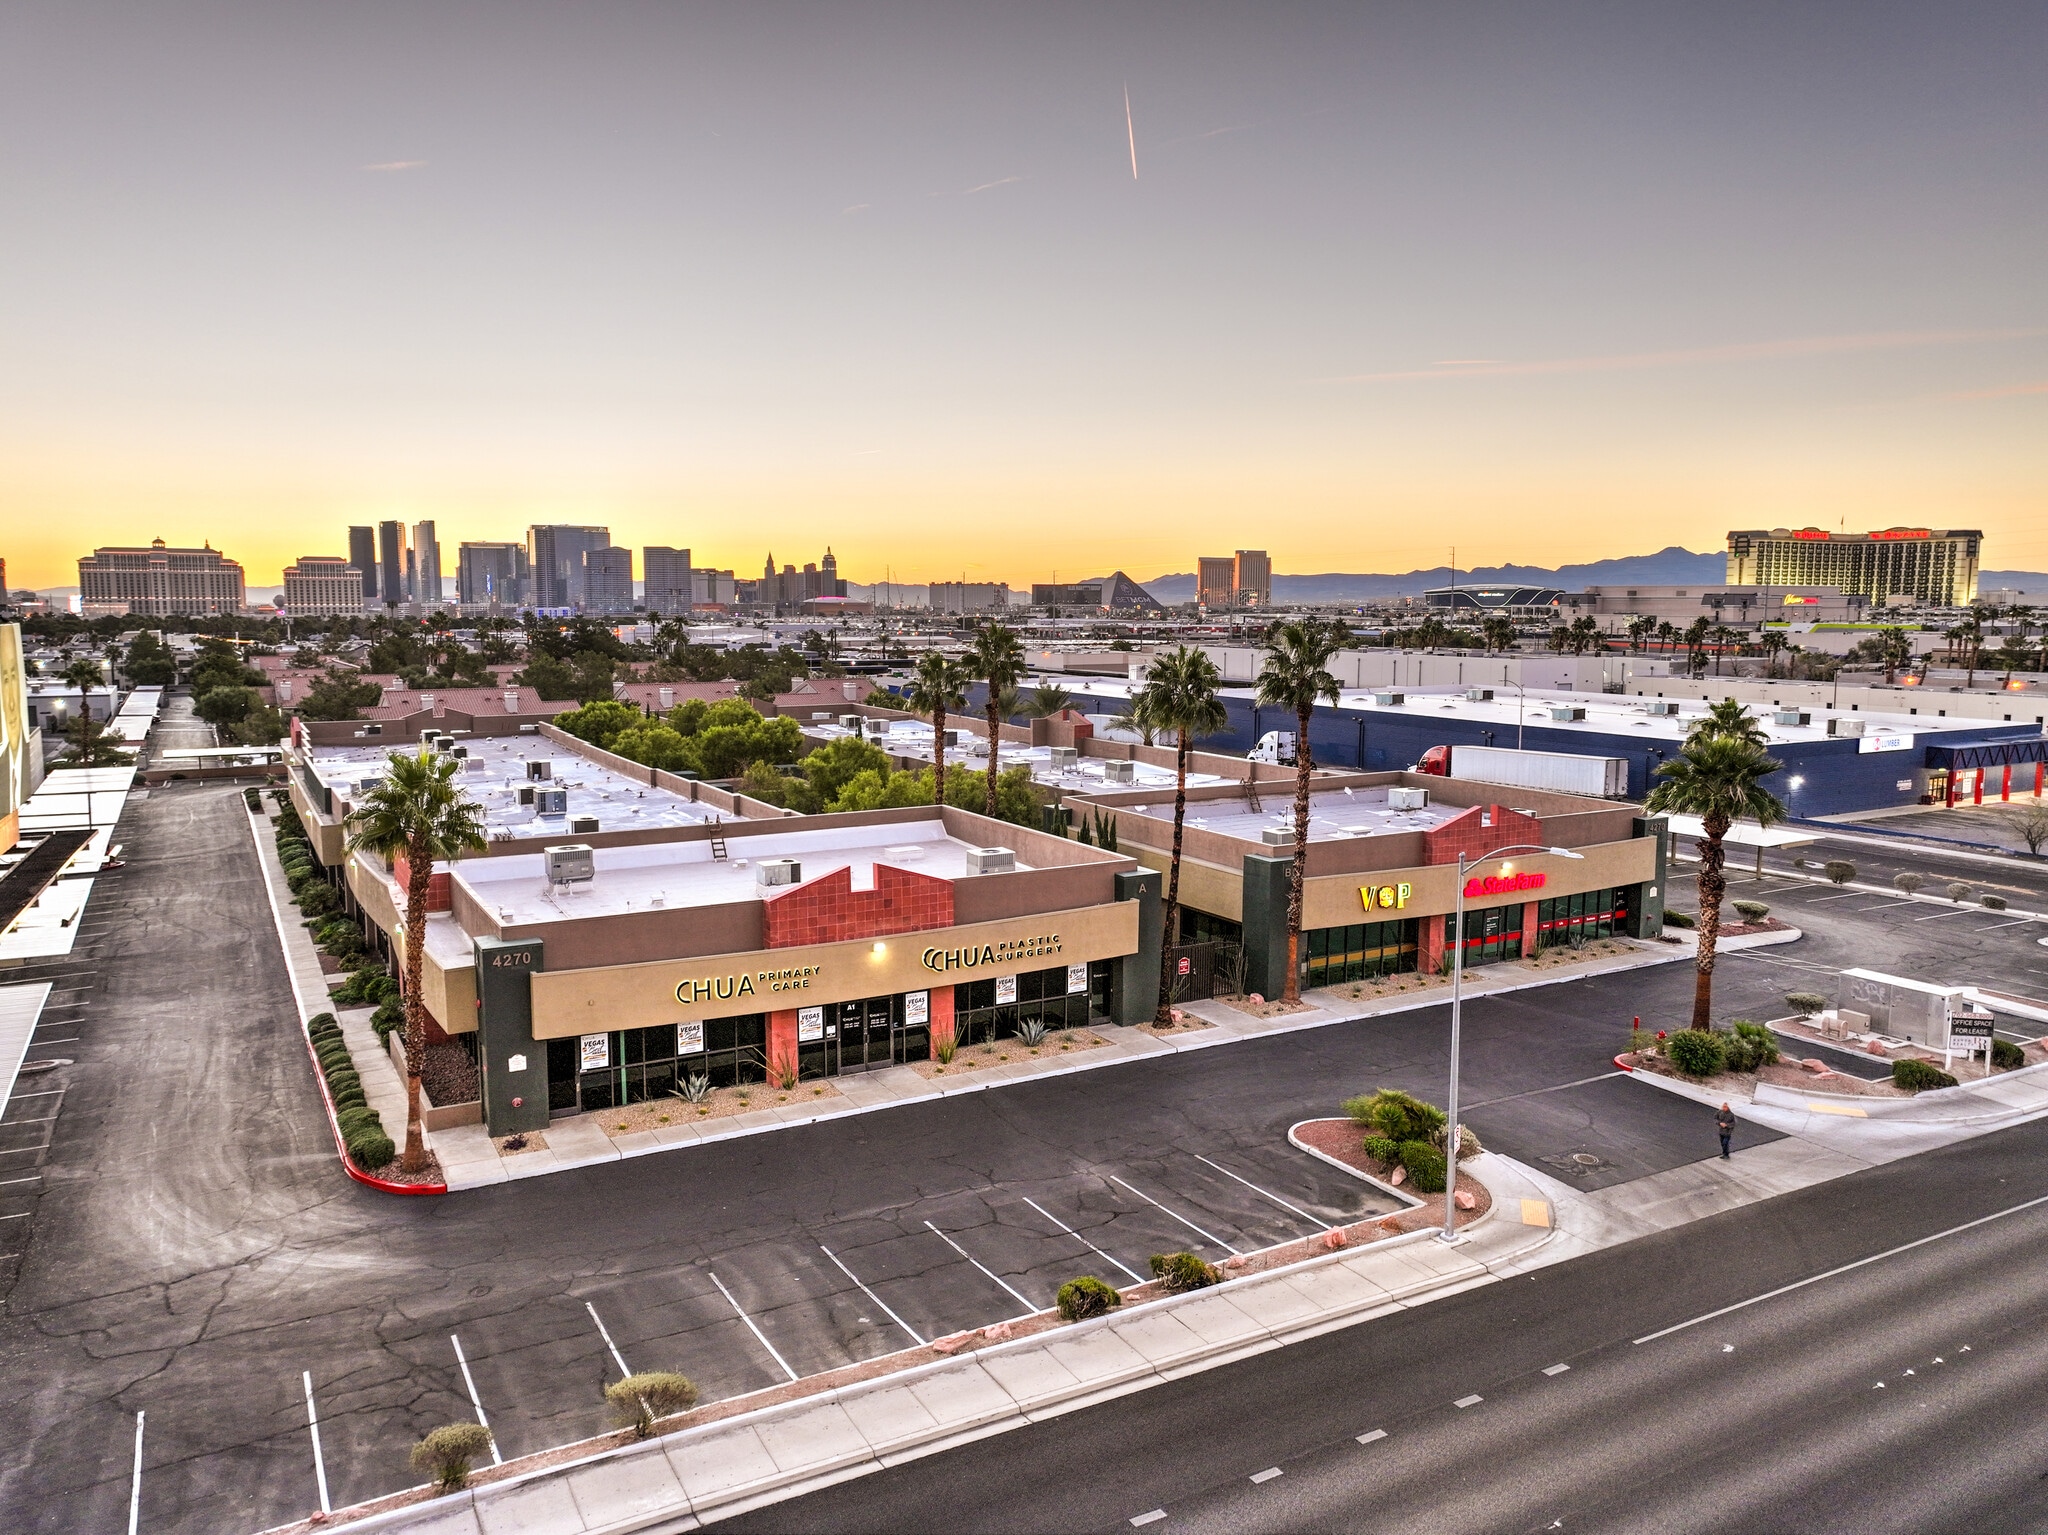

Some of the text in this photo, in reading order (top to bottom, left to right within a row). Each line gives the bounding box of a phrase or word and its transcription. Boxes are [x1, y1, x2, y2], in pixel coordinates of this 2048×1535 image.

[1881, 739, 1900, 748] LUMBER
[1649, 822, 1666, 832] 4270
[1285, 867, 1292, 877] B
[1138, 883, 1147, 893] A
[999, 934, 1060, 950] PLASTIC
[996, 944, 1063, 962] SURGERY
[492, 952, 531, 968] 4270
[758, 966, 820, 983] PRIMARY
[675, 974, 755, 1004] CHUA
[771, 979, 810, 992] CARE
[846, 1003, 856, 1011] A1
